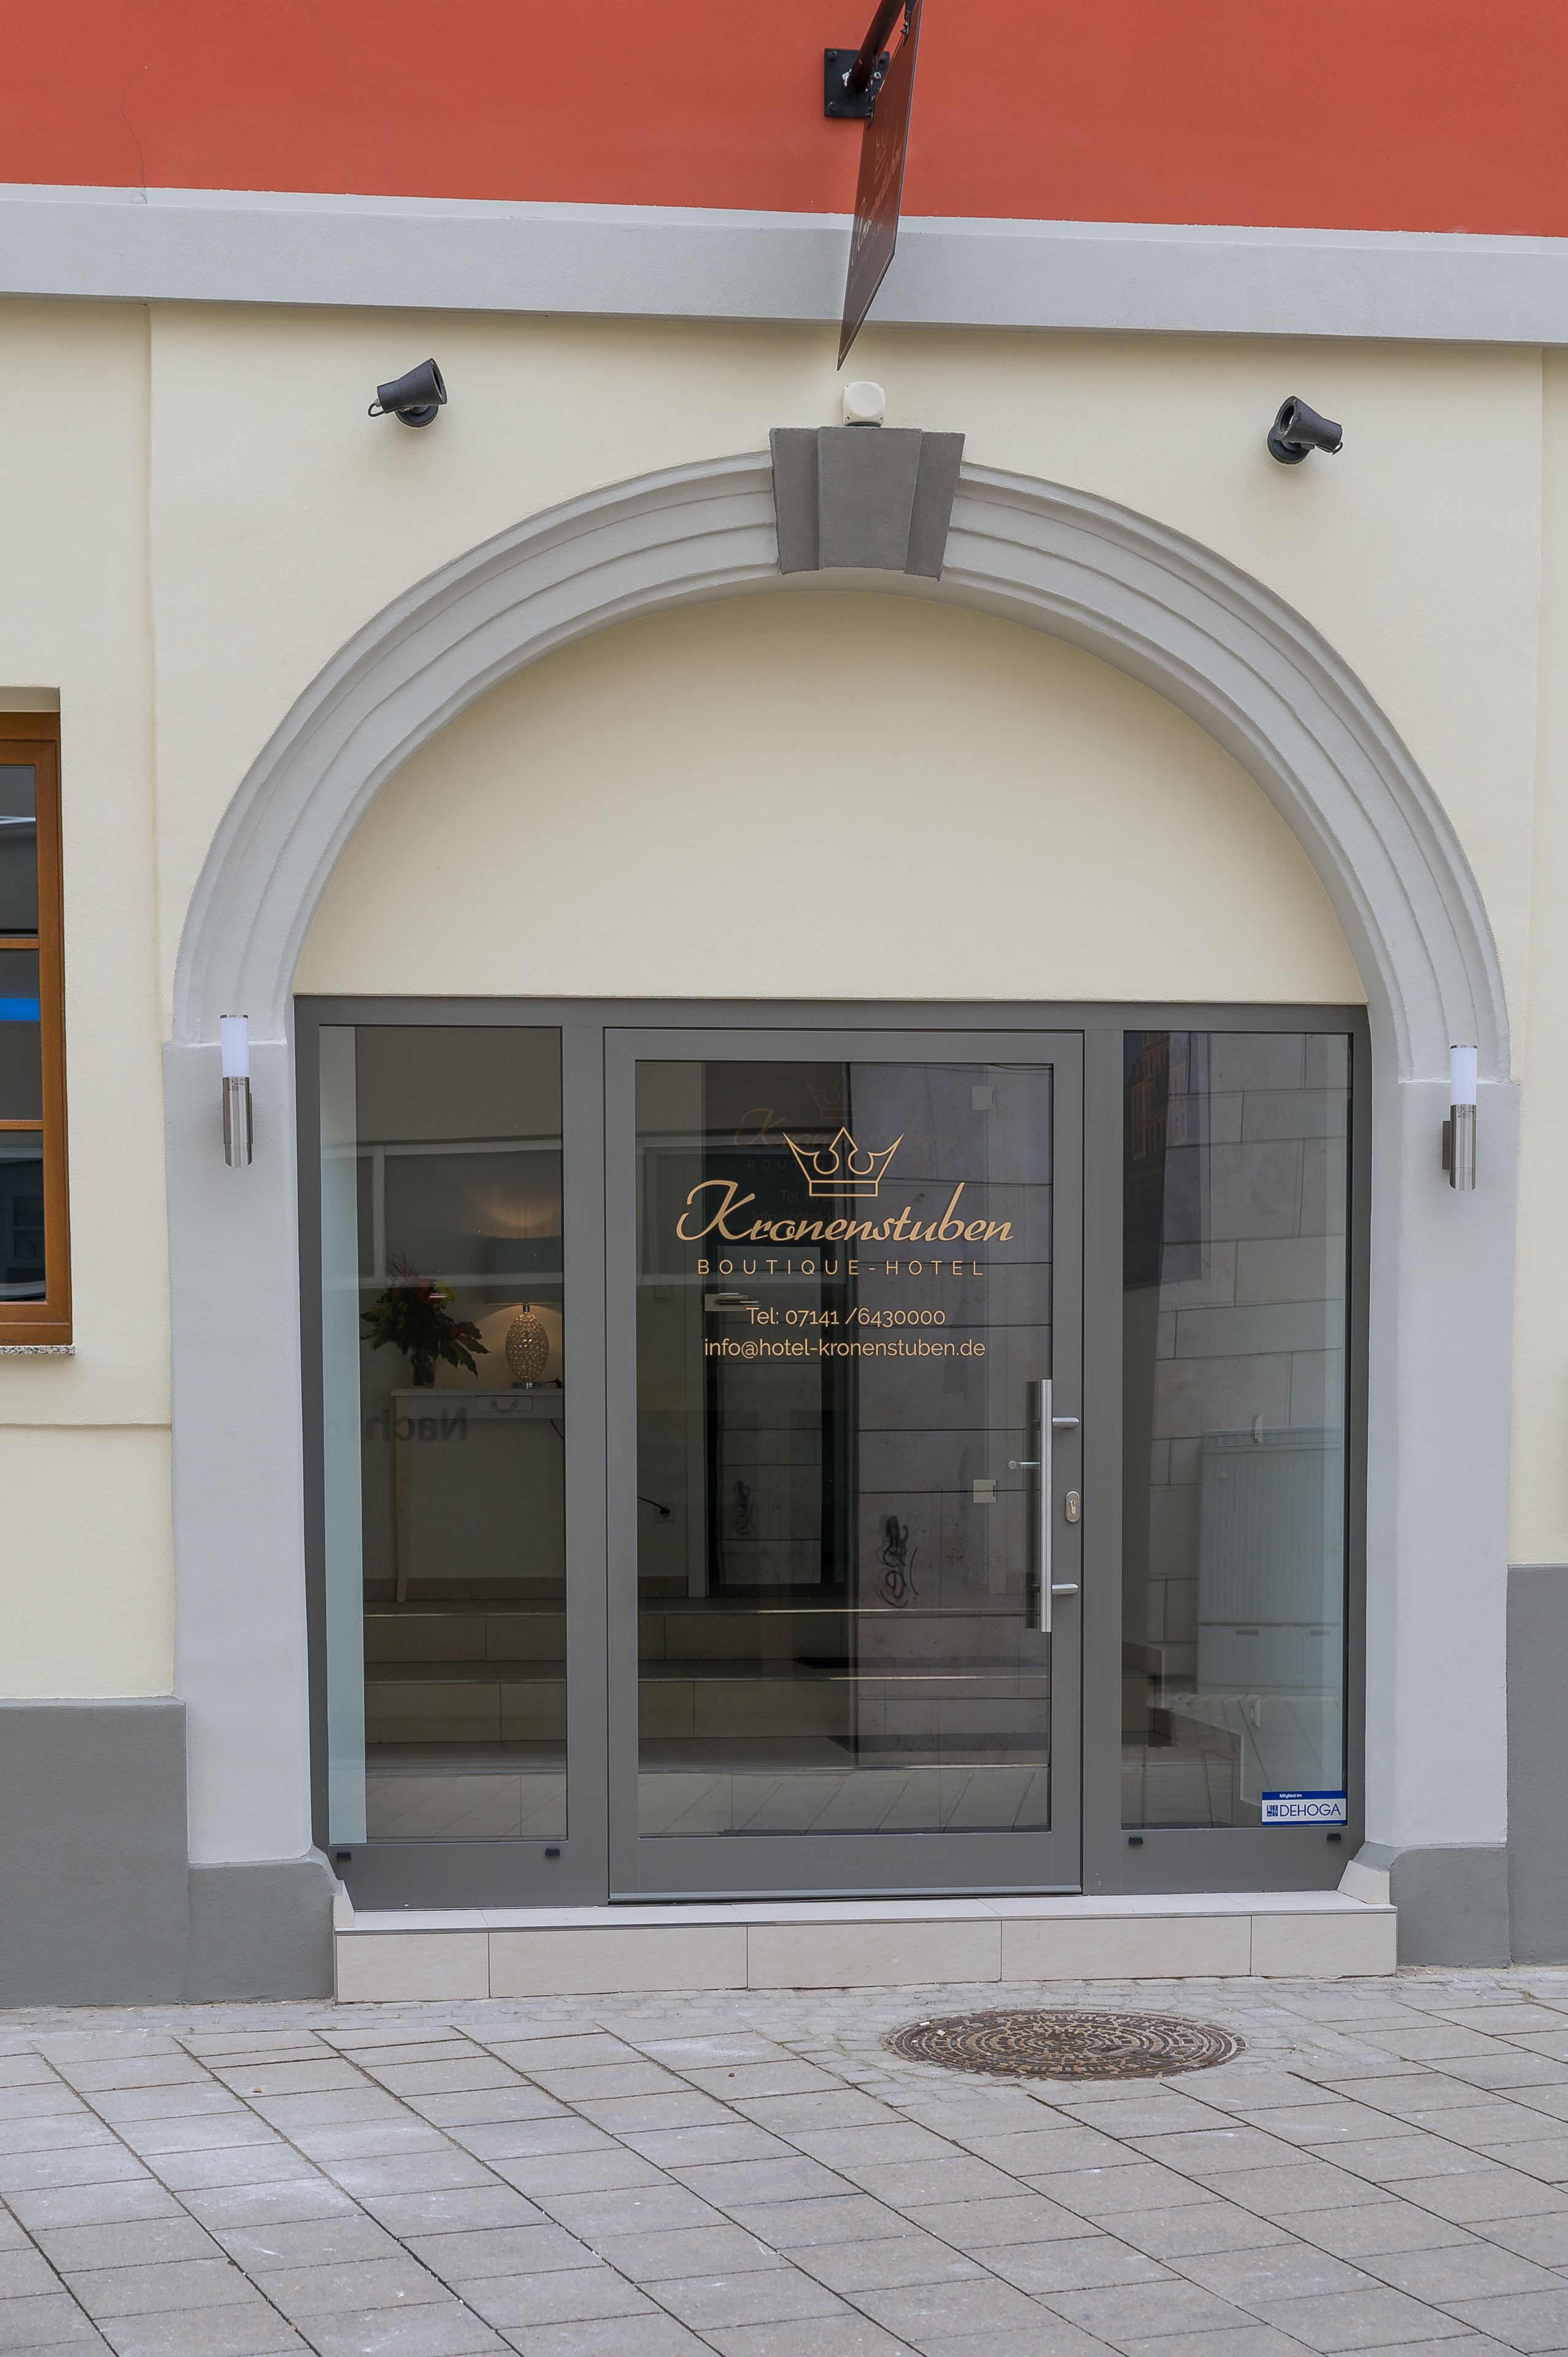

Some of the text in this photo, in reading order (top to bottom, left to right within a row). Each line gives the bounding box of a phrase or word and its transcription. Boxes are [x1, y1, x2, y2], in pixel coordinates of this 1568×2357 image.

[676, 1180, 1014, 1242] Kronenstuben
[697, 1260, 984, 1276] BOUTIQUE-HOTEL
[746, 1307, 946, 1328] Tel: 07141 /6430000
[705, 1338, 986, 1359] info@hotel-kronenstuben.de
[1280, 1803, 1341, 1817] DEHOGA
